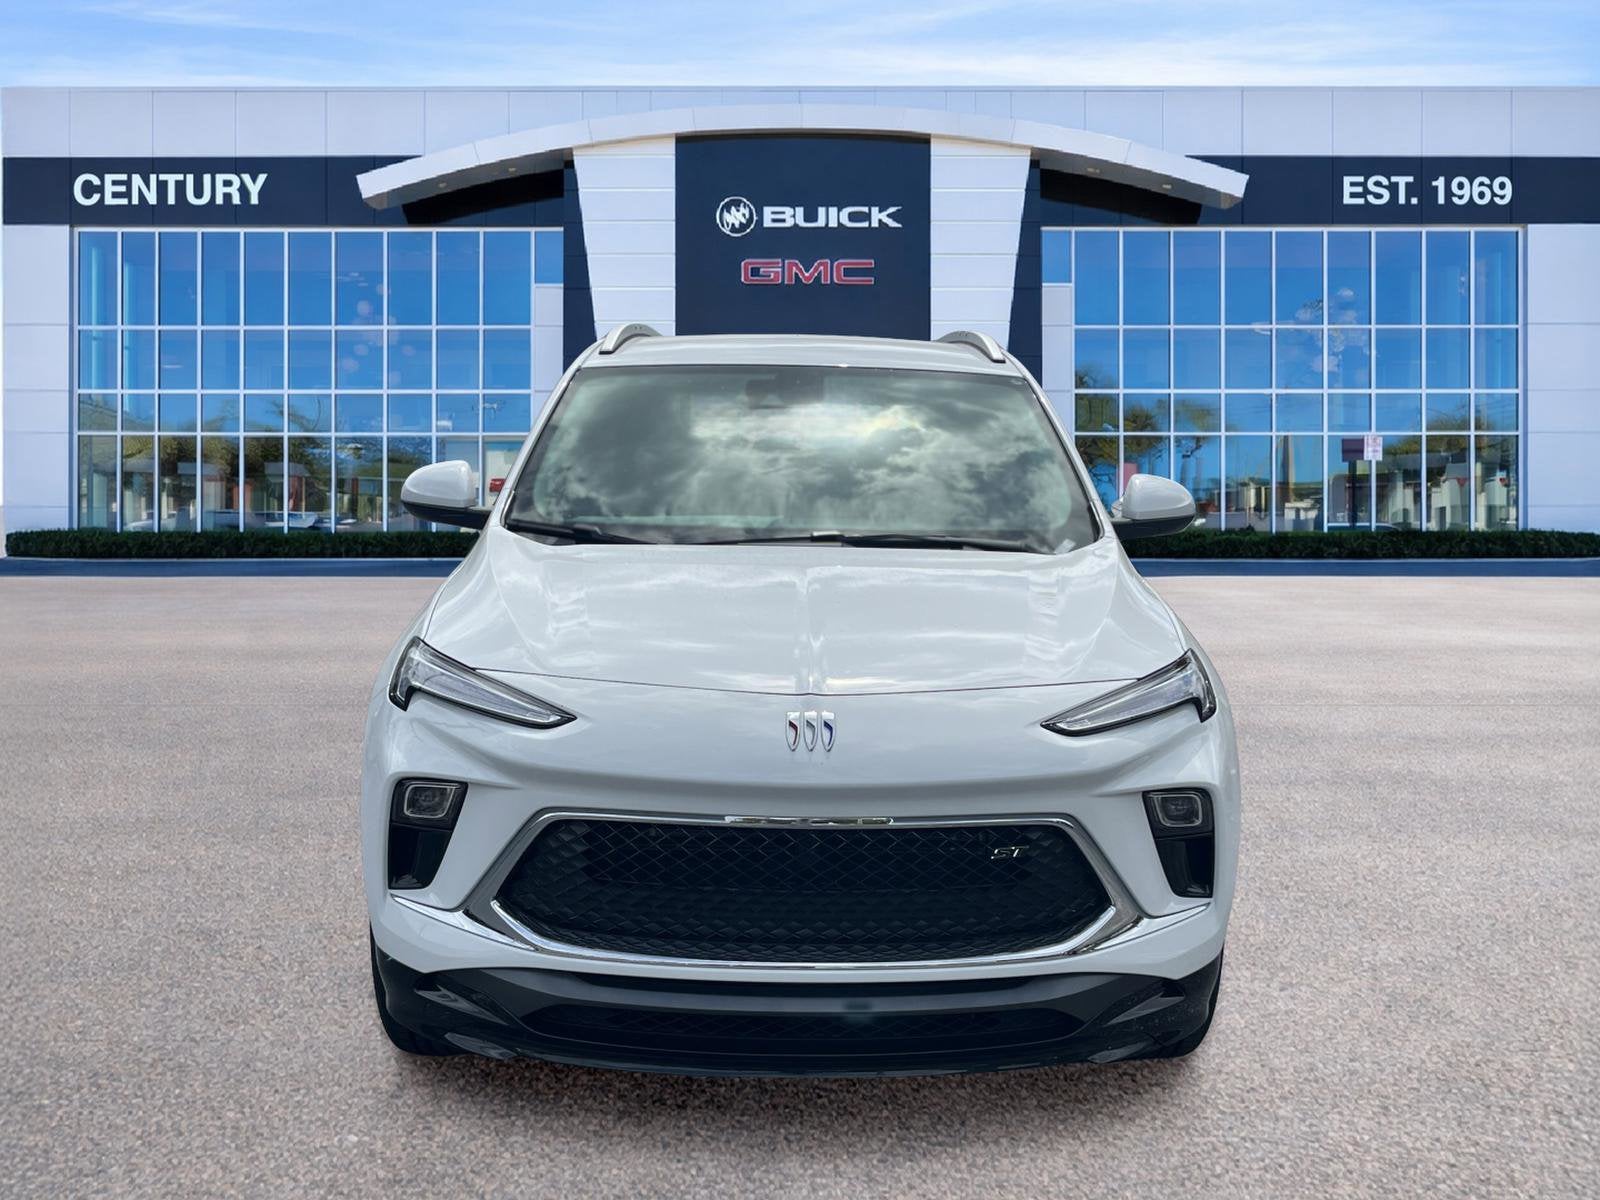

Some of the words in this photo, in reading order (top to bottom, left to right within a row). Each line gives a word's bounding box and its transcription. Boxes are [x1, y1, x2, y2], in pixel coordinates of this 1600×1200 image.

[73, 173, 268, 206] CENTURY
[1342, 175, 1418, 205] EST.
[1431, 175, 1513, 206] 1969
[762, 206, 903, 228] BUICK
[740, 258, 875, 285] GMC
[990, 845, 1029, 860] ST
